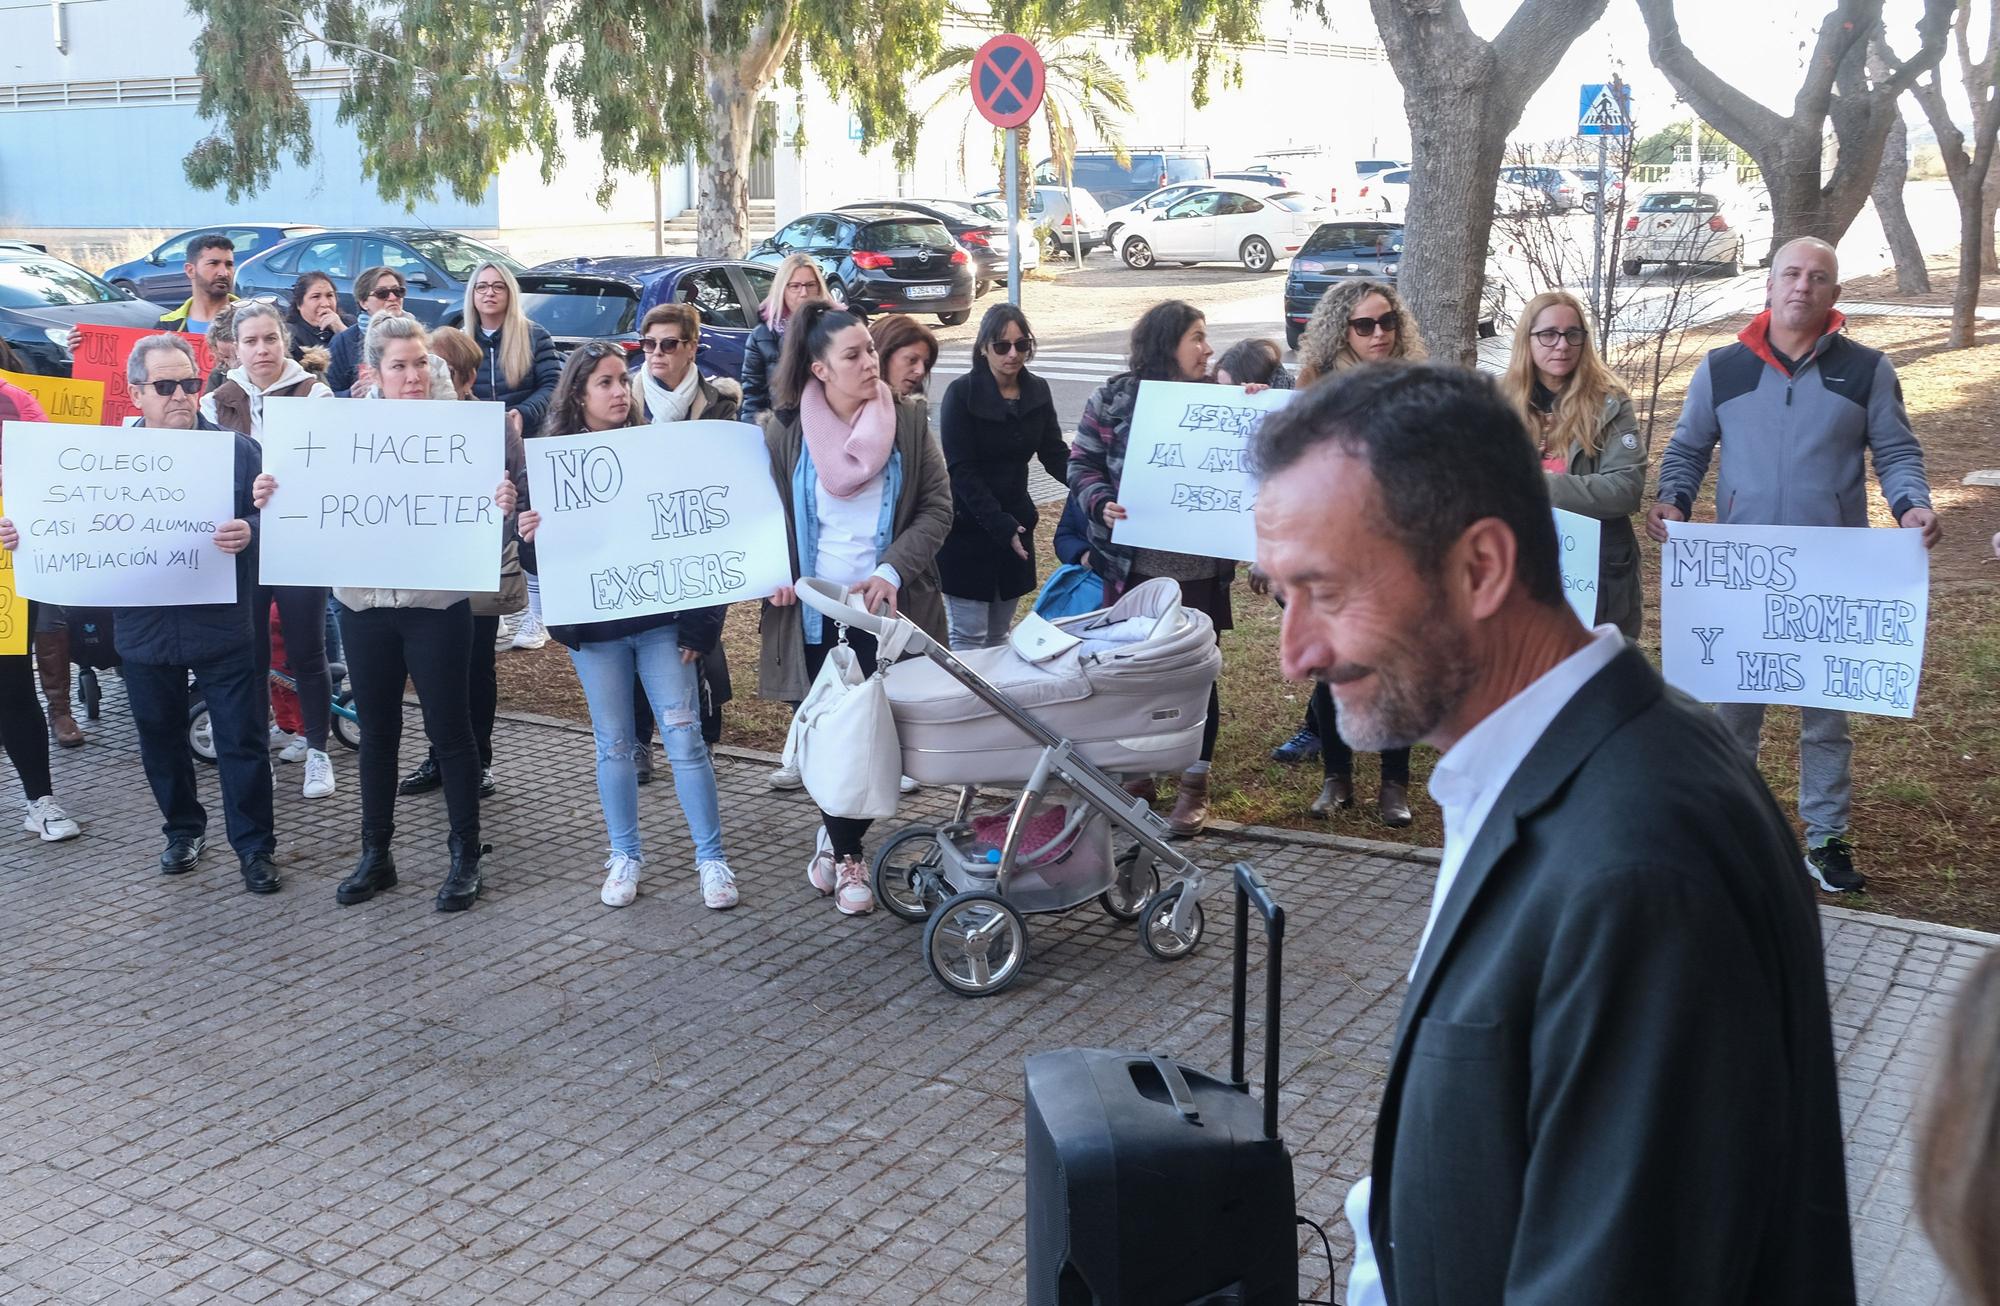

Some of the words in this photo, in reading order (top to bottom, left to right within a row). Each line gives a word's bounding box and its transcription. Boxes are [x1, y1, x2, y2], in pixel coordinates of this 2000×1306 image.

[82, 331, 119, 366] UN
[51, 387, 94, 417] LÍNEAS
[58, 447, 173, 472] COLEGIO
[352, 433, 472, 464] HACER
[1148, 443, 1185, 468] LA
[42, 485, 185, 503] SATURADO
[545, 445, 623, 512] NO
[320, 494, 494, 529] PROMETER
[647, 485, 729, 540] MAS
[1171, 483, 1242, 513] DESDE
[30, 518, 76, 537] CASI
[88, 513, 135, 533] 500
[140, 518, 217, 534] ALUMNOS
[166, 549, 200, 571] YA!!
[1670, 538, 1798, 592] MENOS
[590, 550, 746, 610] EXCUSAS
[1763, 593, 1916, 646] PROMETER
[1692, 628, 1724, 664] Y
[1737, 651, 1805, 692] MAS
[1823, 655, 1915, 709] HACER
